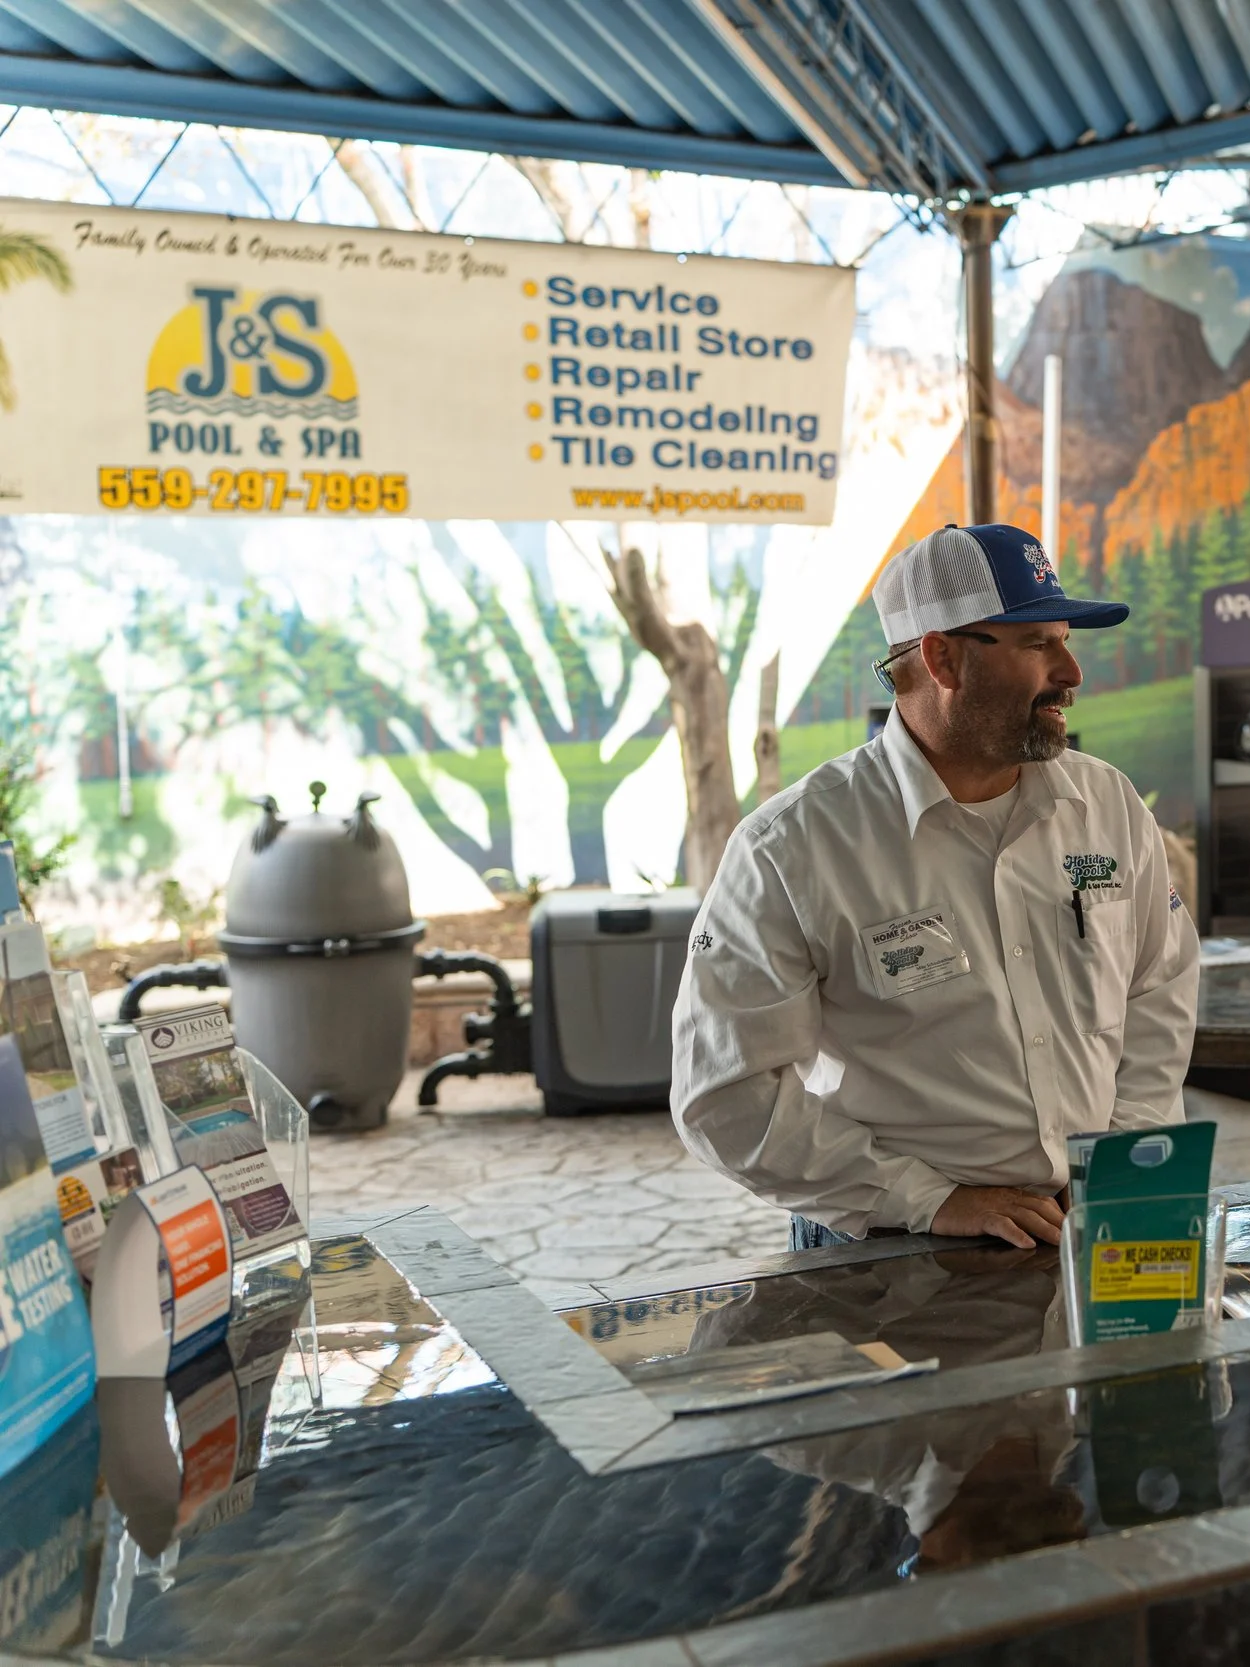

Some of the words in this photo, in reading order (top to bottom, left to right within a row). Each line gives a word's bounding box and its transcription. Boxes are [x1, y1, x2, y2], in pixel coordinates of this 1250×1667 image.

[74, 220, 147, 255] Family
[155, 226, 217, 254] Owned
[226, 234, 238, 256] &
[248, 236, 332, 265] Operated
[337, 242, 371, 270] For
[377, 247, 416, 271] Over
[456, 251, 508, 282] Years
[546, 275, 720, 317] Service
[183, 285, 327, 399] J&S
[548, 316, 681, 353] Retail
[697, 325, 814, 361] Store
[549, 356, 704, 397] Repair
[147, 420, 242, 457] POOL
[257, 426, 284, 458] &
[302, 427, 362, 460] SPA
[551, 395, 819, 443] Remodeling
[551, 435, 636, 468] Tile
[651, 439, 840, 481] Cleaning
[98, 465, 410, 514] 559-297-7995
[571, 484, 807, 516] www.jspool.com
[1063, 854, 1116, 871] Holiday
[1070, 864, 1110, 889] Pools
[872, 930, 900, 944] HOME
[899, 927, 908, 936] &
[173, 1015, 224, 1036] VIKING
[7, 1239, 65, 1297] WATER
[1139, 1246, 1159, 1262] CASH
[18, 1274, 75, 1329] TESTING
